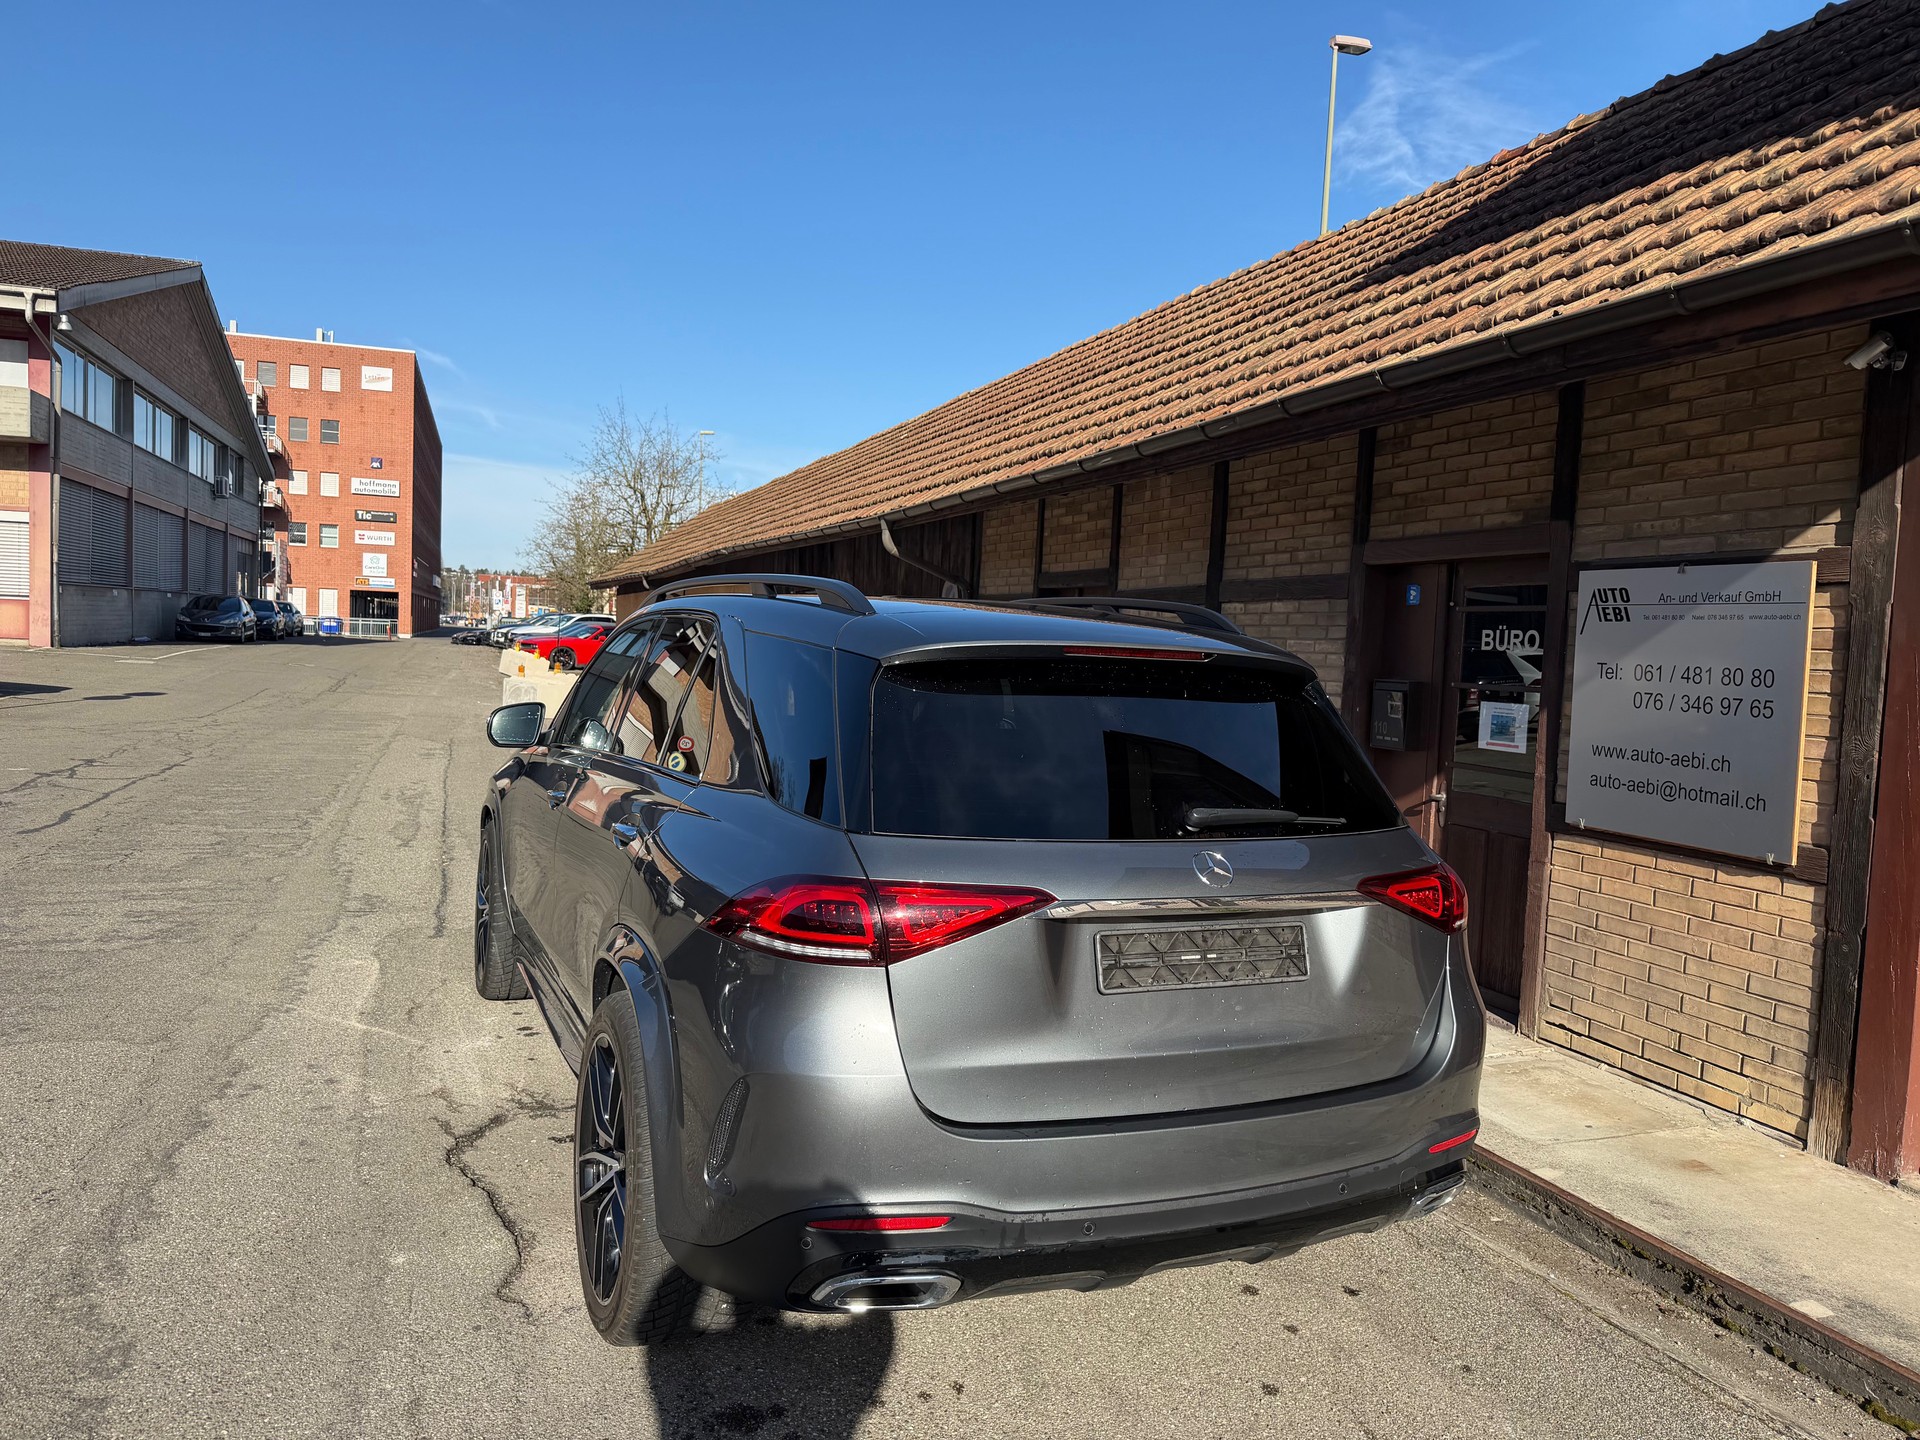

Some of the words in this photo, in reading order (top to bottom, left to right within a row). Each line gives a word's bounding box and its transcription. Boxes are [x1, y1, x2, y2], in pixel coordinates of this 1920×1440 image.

[354, 487, 397, 495] automobile
[359, 479, 397, 488] hoffmann
[356, 510, 372, 520] Tic
[1658, 593, 1676, 604] An-
[1678, 592, 1698, 603] und
[1700, 591, 1742, 603] Verkauf
[1744, 590, 1782, 602] GmbH
[1481, 625, 1540, 652] BÜRO
[1597, 662, 1623, 680] Tel:
[1634, 664, 1662, 682] 061
[1669, 665, 1677, 683] /
[1680, 666, 1712, 685] 481
[1721, 667, 1744, 687] 80
[1751, 668, 1775, 688] 80
[1633, 691, 1664, 711] 076
[1668, 693, 1676, 712] /
[1680, 694, 1713, 714] 346
[1720, 697, 1743, 716] 97
[1750, 699, 1774, 719] 65
[1592, 744, 1731, 773] www.auto-aebi.ch
[1590, 773, 1767, 812] auto-aebi@hotmail.ch
